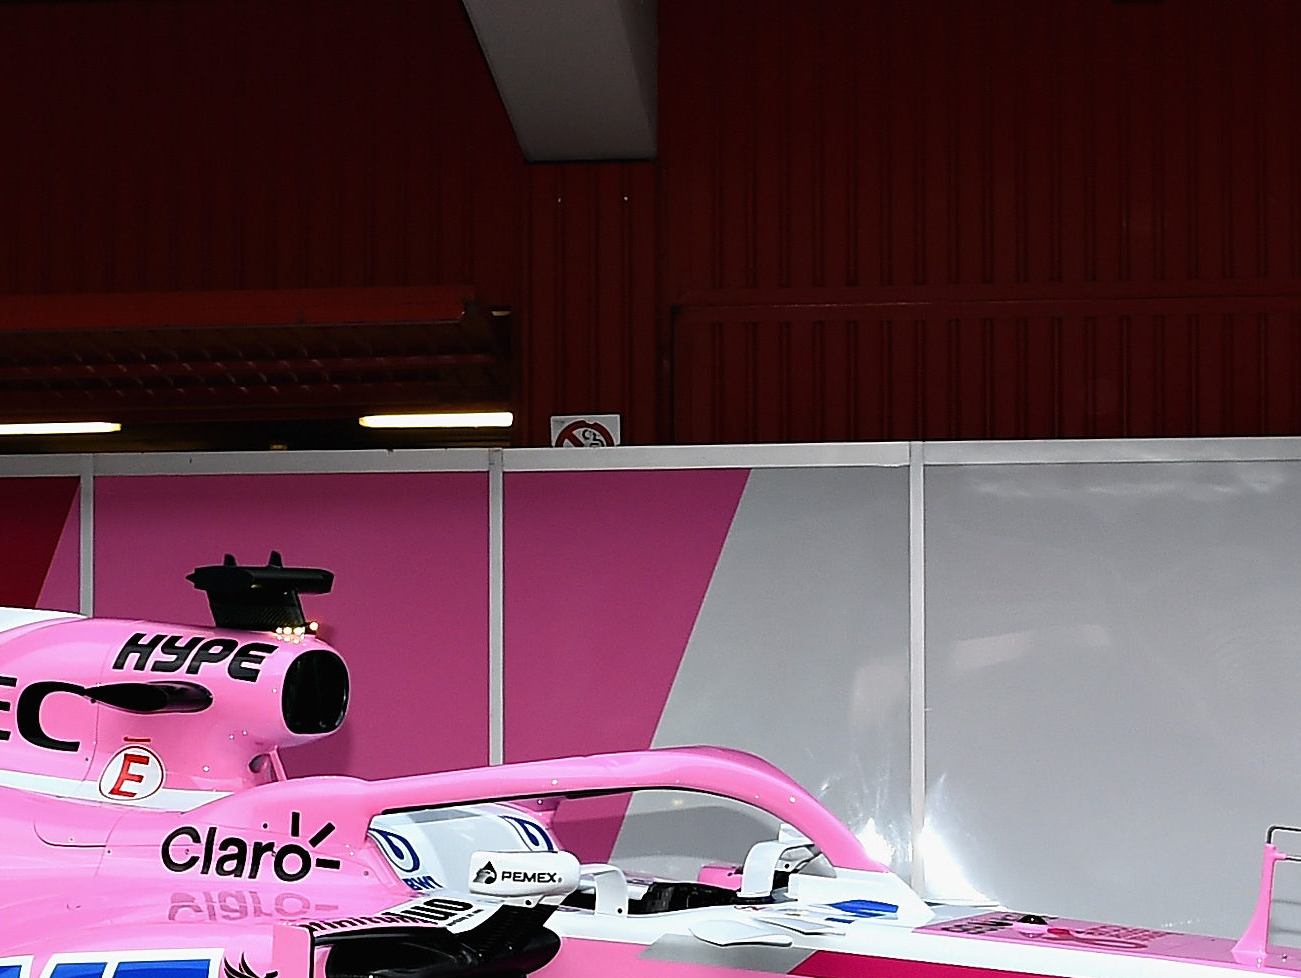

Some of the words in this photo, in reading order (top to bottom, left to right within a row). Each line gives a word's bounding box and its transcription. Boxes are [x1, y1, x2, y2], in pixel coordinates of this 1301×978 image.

[111, 632, 278, 683] HYPE
[108, 753, 151, 799] E
[161, 826, 312, 882] Claro
[501, 871, 557, 883] PEMEX
